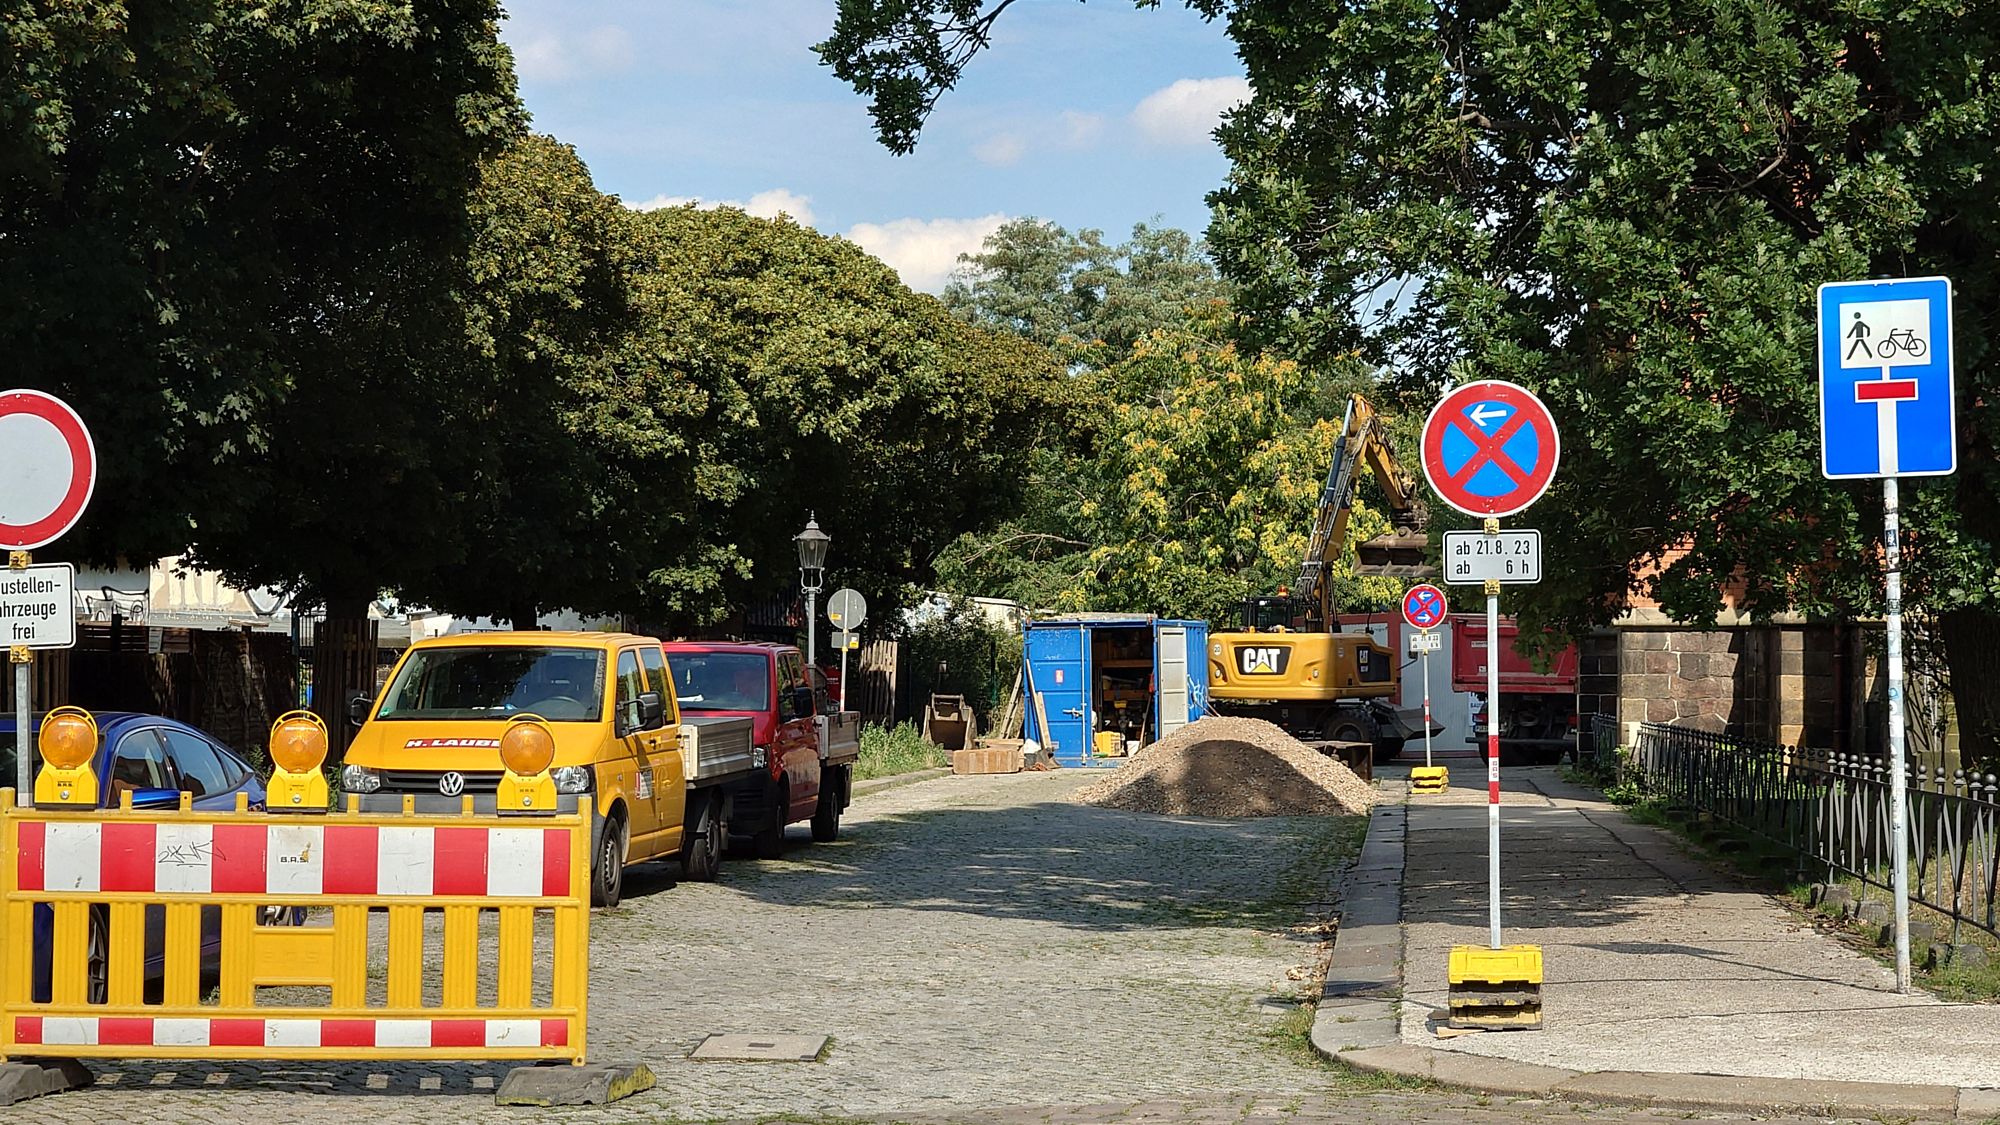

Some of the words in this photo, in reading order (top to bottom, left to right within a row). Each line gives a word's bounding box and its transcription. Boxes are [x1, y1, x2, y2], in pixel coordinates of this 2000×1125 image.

[1456, 541, 1470, 555] ab
[1514, 540, 1530, 555] 23
[1456, 560, 1470, 575] ab
[1506, 560, 1513, 574] 6
[1522, 560, 1529, 574] h
[1, 576, 61, 594] ustellen-
[12, 621, 35, 640] frei
[1243, 648, 1280, 673] CAT
[406, 740, 427, 748] H.
